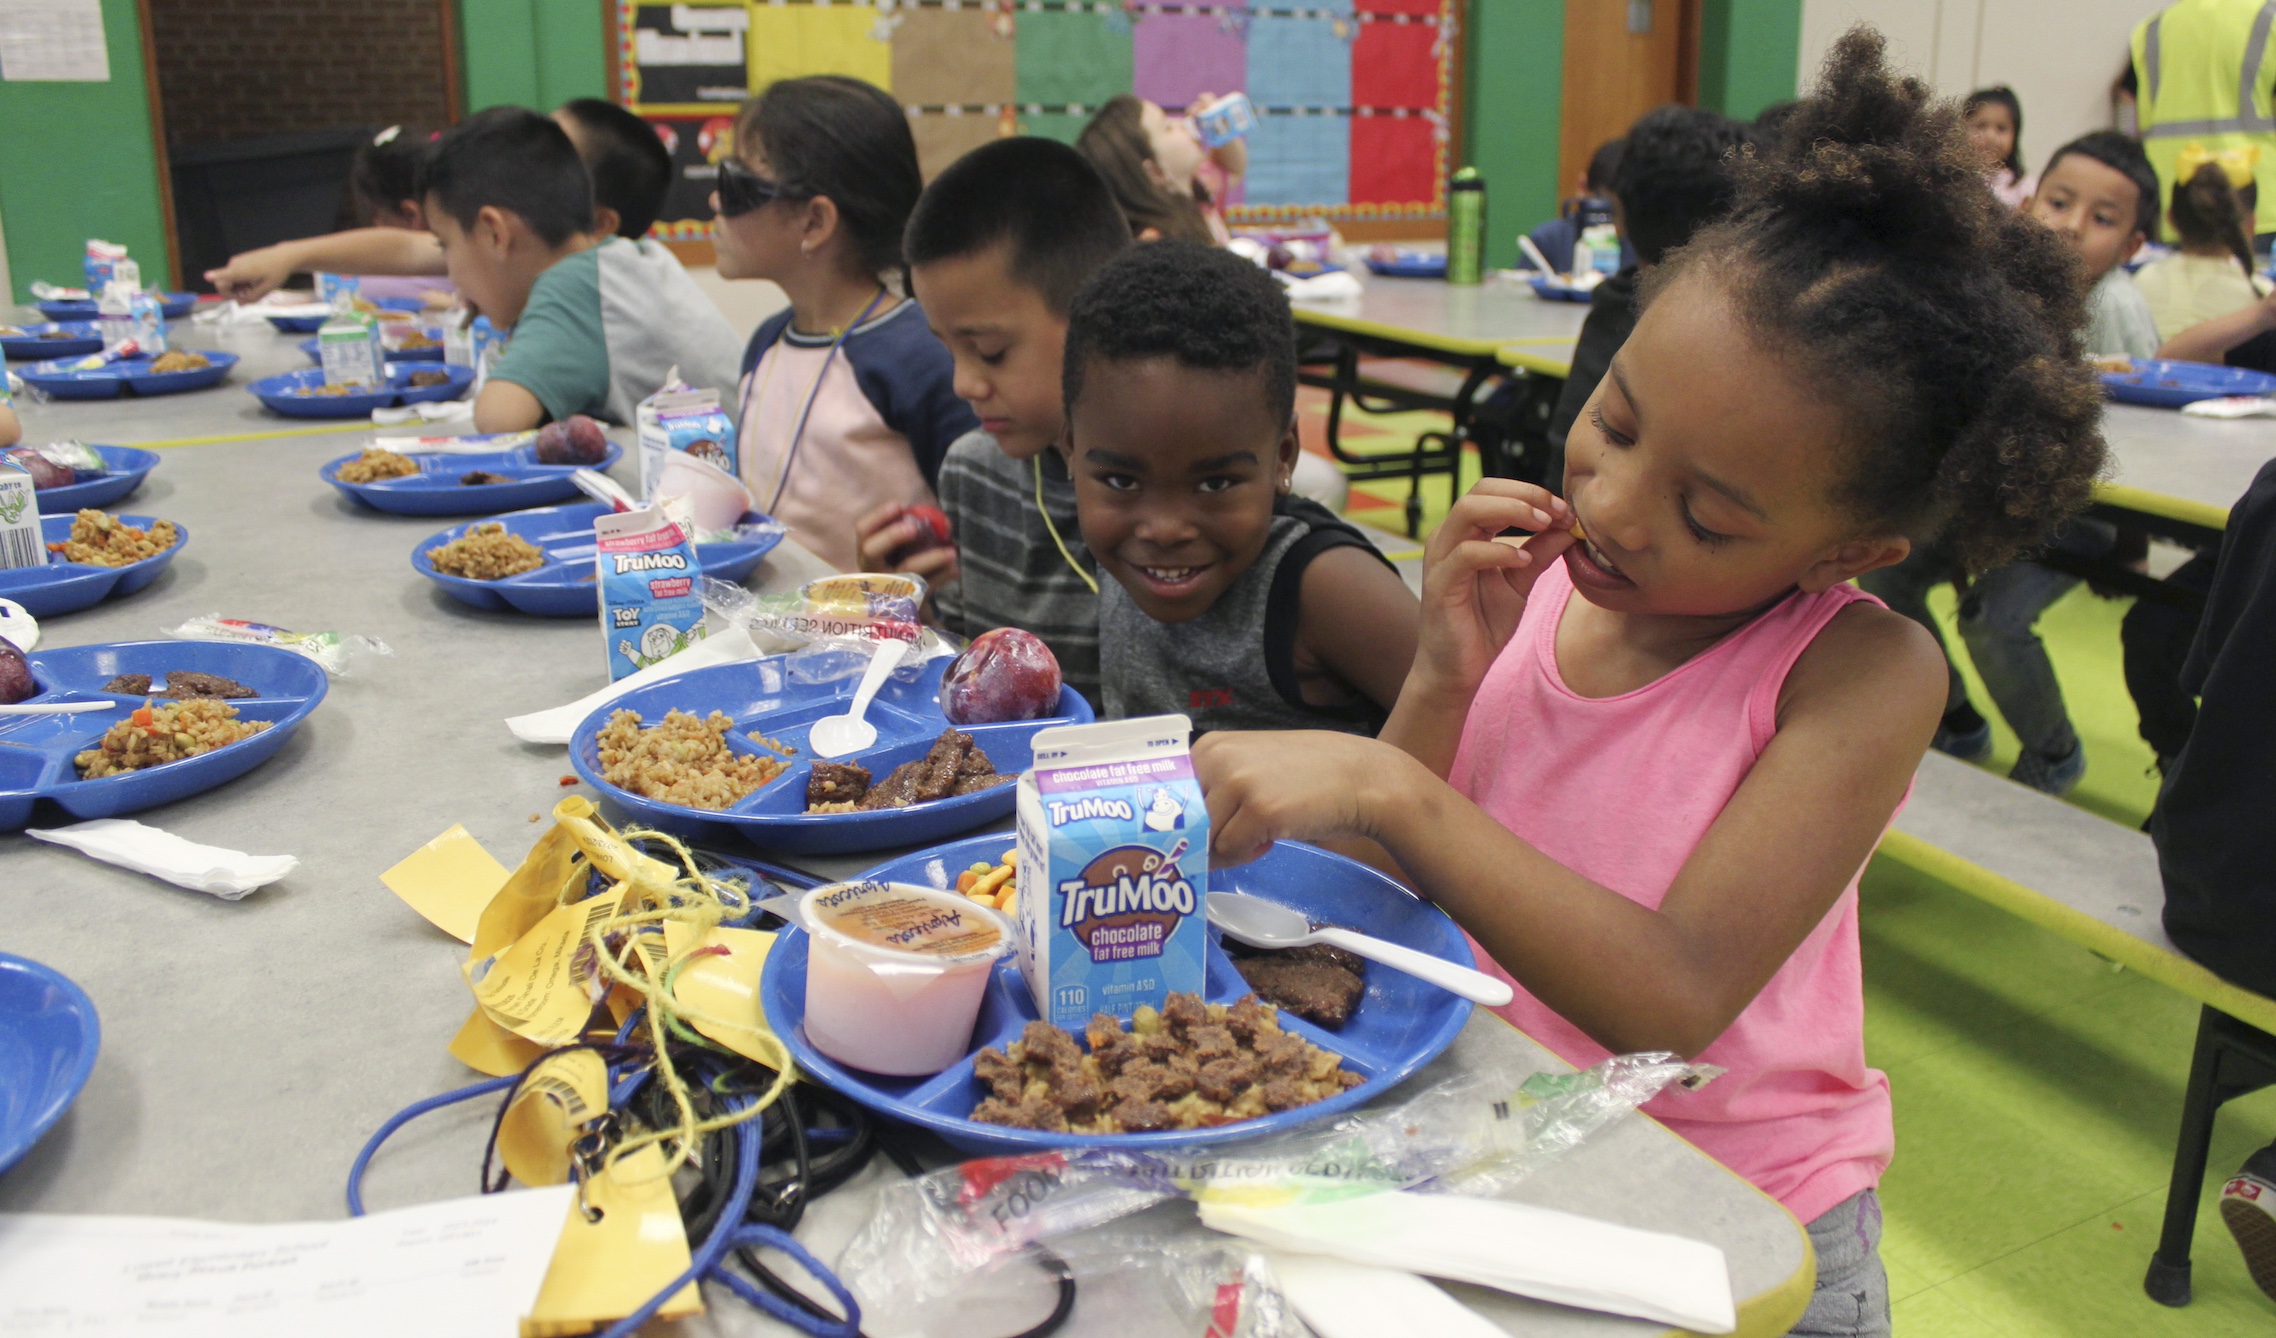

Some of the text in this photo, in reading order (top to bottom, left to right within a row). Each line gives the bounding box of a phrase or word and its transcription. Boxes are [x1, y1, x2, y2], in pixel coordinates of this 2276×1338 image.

[604, 537, 645, 547] strawberry
[612, 553, 687, 575] TruMoo
[649, 577, 692, 590] strawberry
[612, 606, 641, 621] TOY
[1155, 739, 1170, 747] OPEN
[1052, 759, 1177, 784] chocolate fat free milk
[1048, 798, 1133, 827] TruMoo
[816, 879, 891, 908] Apricots
[1060, 875, 1195, 927] TruMoo
[885, 909, 962, 944] Apricots
[1091, 923, 1163, 946] chocolate
[1094, 942, 1160, 961] fat free milk
[1059, 989, 1084, 1005] 110
[1102, 983, 1135, 996] vitamin
